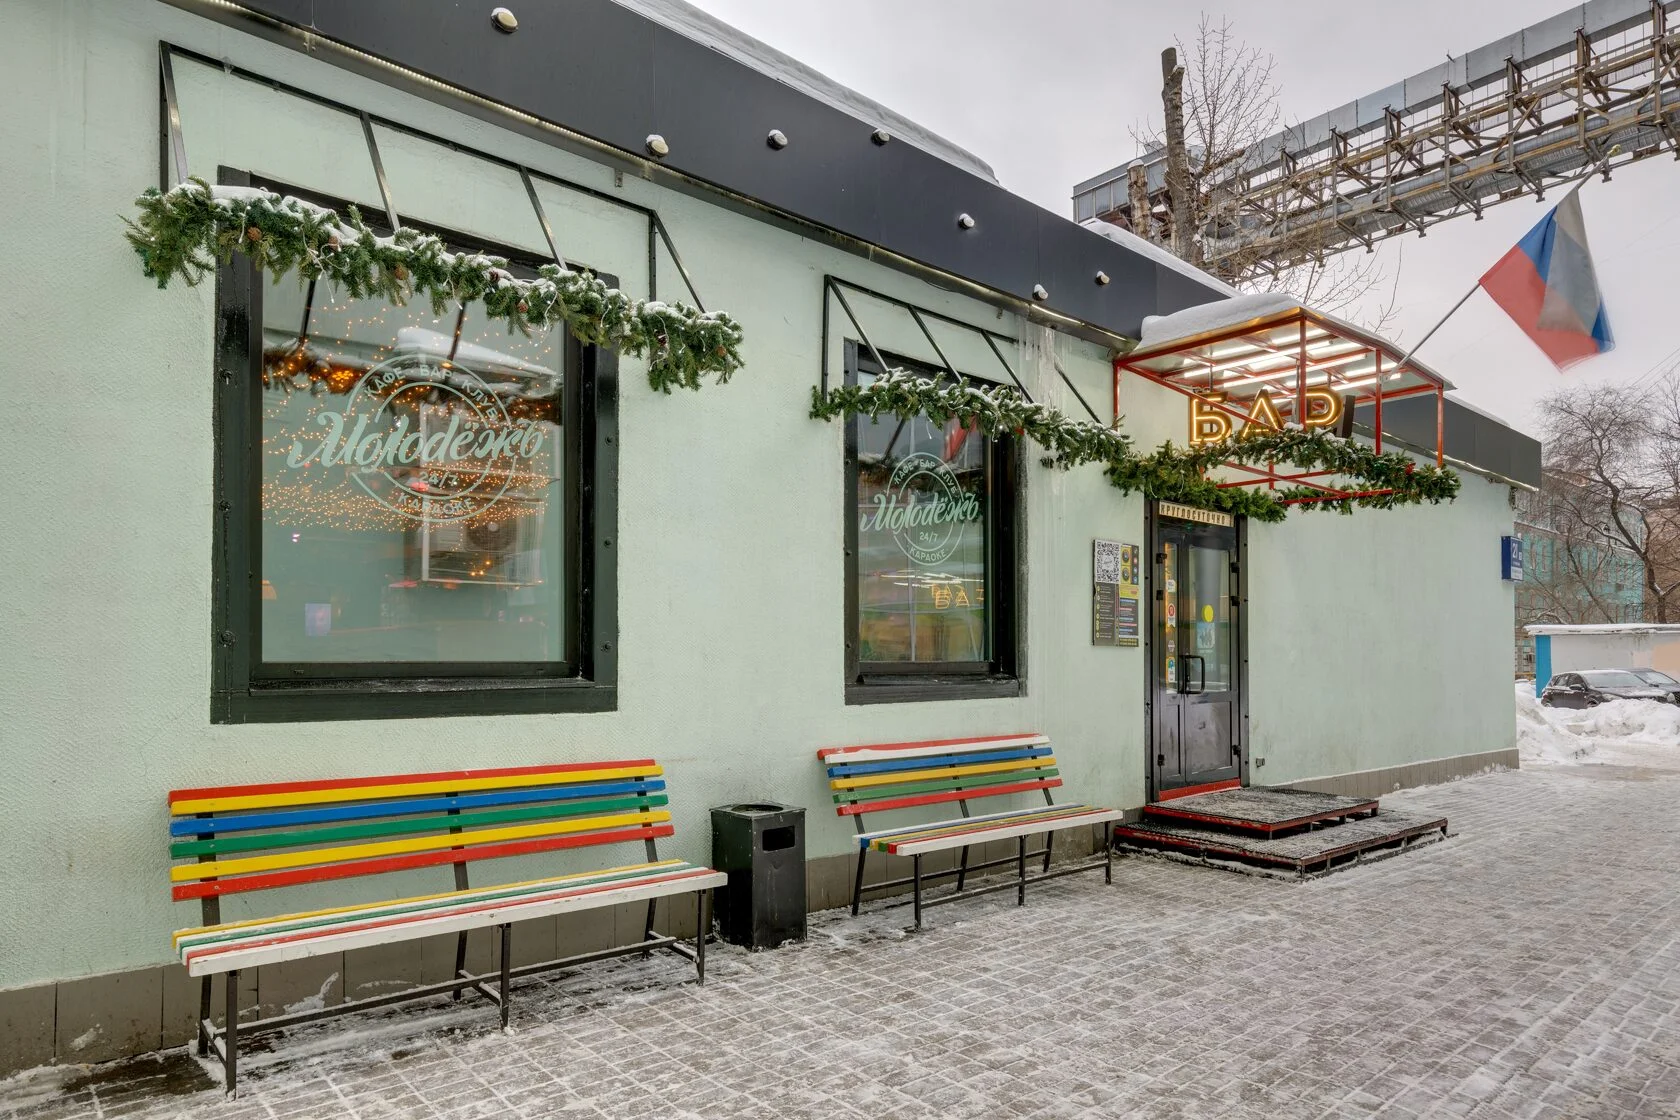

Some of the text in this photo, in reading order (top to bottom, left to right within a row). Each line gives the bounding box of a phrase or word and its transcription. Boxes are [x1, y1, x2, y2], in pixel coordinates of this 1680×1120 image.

[364, 364, 499, 419] КАФЕ БАР КЛУБ
[1188, 386, 1343, 446] БАР
[419, 471, 459, 488] 24/7
[894, 459, 958, 494] КАФЕ БАР КЛУБ
[398, 492, 477, 515] КАРАОКЕ
[1160, 503, 1226, 525] КРУГЛОСУТОЧНО
[920, 531, 938, 543] 24/7
[910, 547, 947, 561] КАРАОКЕ
